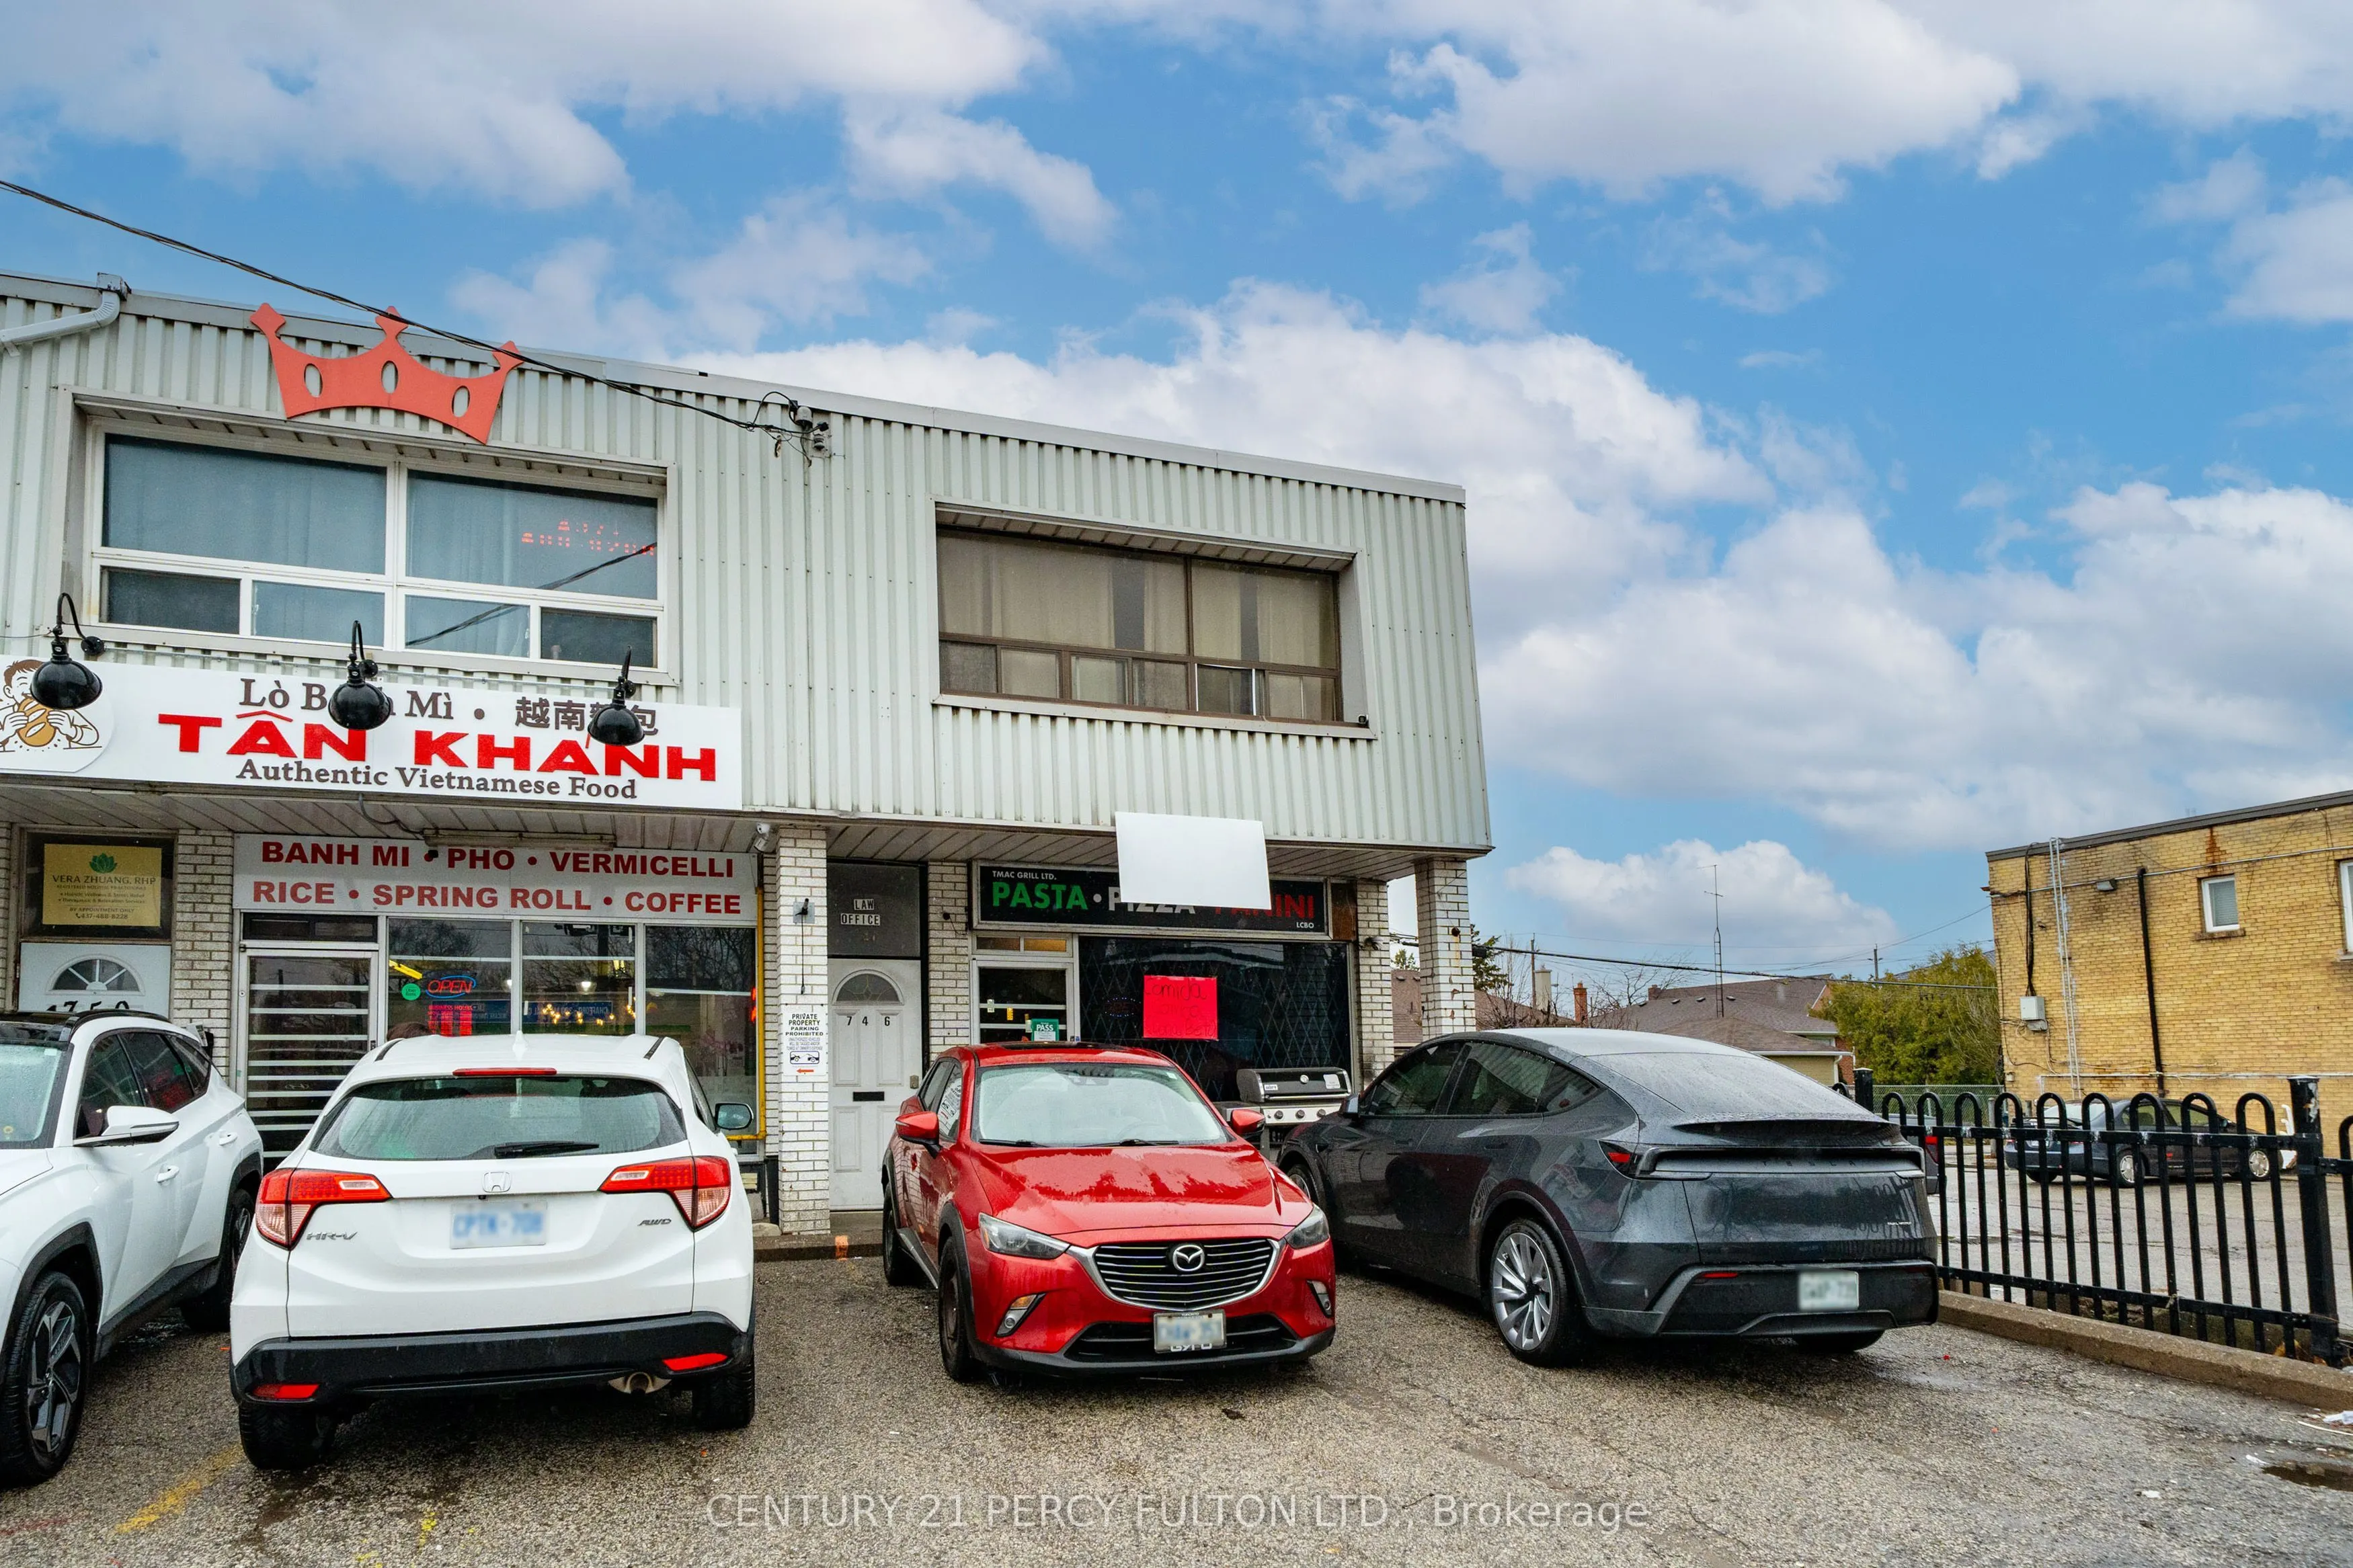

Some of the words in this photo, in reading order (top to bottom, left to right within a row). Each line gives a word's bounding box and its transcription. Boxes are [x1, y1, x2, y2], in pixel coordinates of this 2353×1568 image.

[239, 678, 290, 708] Lò
[405, 690, 454, 720] Mì
[515, 697, 658, 736] 越南包
[158, 710, 366, 761] TÂN
[236, 759, 388, 785] Authentic
[395, 767, 560, 794] Vietnamese
[568, 776, 637, 799] Food
[262, 841, 359, 865] BANH
[372, 845, 409, 866] MI
[448, 848, 515, 870] PHO
[549, 852, 733, 878] VERMICELLI
[52, 875, 81, 883] VERA
[134, 876, 157, 885] RHP
[992, 870, 1015, 878] TMAC
[1017, 872, 1039, 880] GRILL
[253, 881, 335, 904] RICE
[372, 884, 498, 908] SPRING
[510, 888, 592, 911] ROLL
[625, 891, 741, 914] COFFEE
[854, 900, 874, 909] LAW
[992, 881, 1088, 910] PASTA
[1215, 894, 1314, 919] INI
[841, 914, 879, 925] OFFICE
[428, 979, 473, 993] OPEN
[637, 1219, 672, 1227] AWD
[307, 1231, 358, 1241] HR-V
